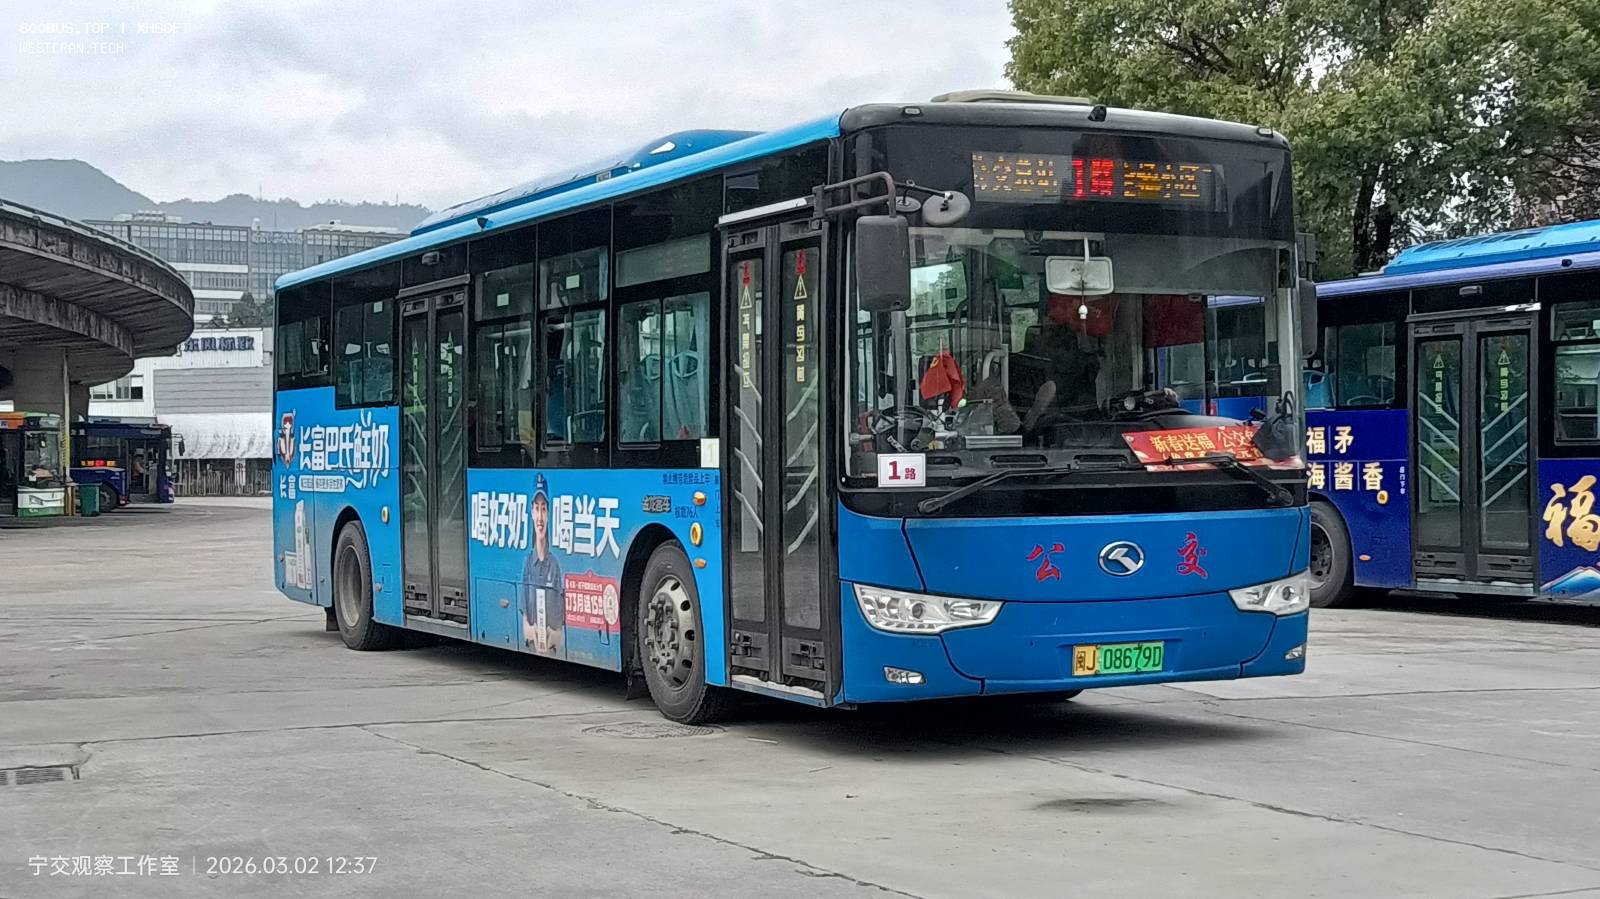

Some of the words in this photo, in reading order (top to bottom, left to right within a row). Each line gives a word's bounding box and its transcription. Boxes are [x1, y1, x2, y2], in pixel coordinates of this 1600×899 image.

[299, 408, 389, 488] 长富巴氏鲜奶
[1150, 432, 1215, 452] 新春送福
[280, 475, 296, 499] 长富
[889, 460, 916, 480] 1路
[471, 491, 529, 550] 喝好奶
[552, 495, 620, 559] 喝当天
[1026, 542, 1066, 583] 公
[1176, 532, 1209, 580] 交
